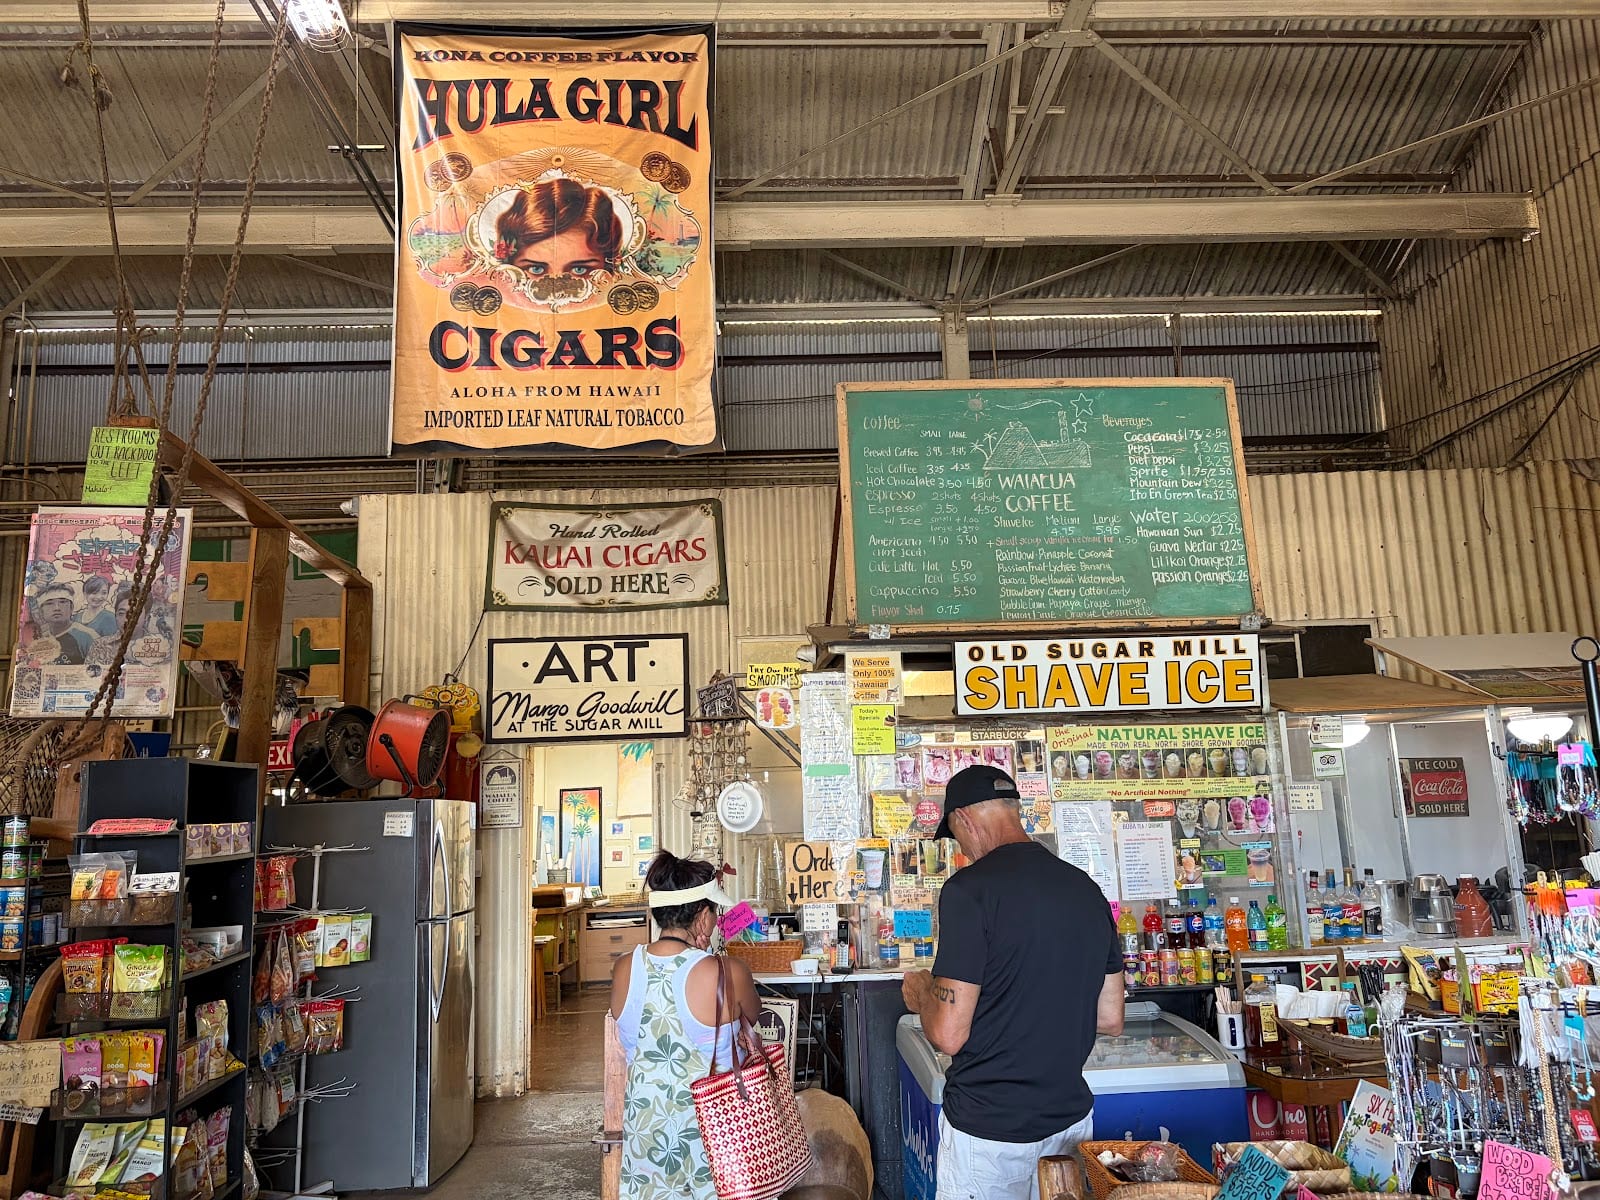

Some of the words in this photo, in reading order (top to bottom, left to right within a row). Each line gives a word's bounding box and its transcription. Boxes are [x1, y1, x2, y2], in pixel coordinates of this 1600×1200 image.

[413, 50, 482, 62] KONA
[489, 50, 592, 62] COFFEE
[596, 50, 699, 63] FLAVOR
[411, 78, 562, 152] HULA
[566, 77, 699, 152] GIRL
[429, 315, 686, 371] CIGARS
[450, 386, 516, 398] ALOHA
[525, 385, 581, 397] FROM
[589, 384, 661, 397] HAWAII
[423, 410, 503, 429] IMPORTED
[507, 409, 542, 427] LEAF
[545, 409, 613, 427] NATURAL
[617, 407, 684, 426] TOBACCO
[863, 415, 901, 430] Coffee
[1102, 414, 1153, 429] Beverages
[95, 429, 156, 445] RESTROOMS
[920, 430, 942, 438] SMALL
[90, 445, 111, 459] OUT
[863, 446, 891, 457] Brewed
[894, 446, 919, 457] Coffee
[1128, 443, 1154, 454] Pepsi
[1129, 455, 1149, 466] Diet
[111, 462, 143, 479] LEFT
[865, 463, 884, 474] Iced
[888, 463, 918, 474] Coffee
[926, 464, 945, 475] 3.25
[1130, 466, 1169, 478] Sprite
[887, 475, 936, 487] Chocolate
[938, 478, 962, 489] 3.50
[1130, 477, 1179, 488] Mountain
[1181, 479, 1201, 488] Dew
[1149, 488, 1161, 499] En
[1165, 489, 1194, 500] Green
[868, 504, 923, 516] Espresso
[934, 504, 958, 514] 3.50
[973, 503, 998, 515] 4.50
[1005, 493, 1077, 513] COFFEE
[900, 517, 922, 525] Ice
[1045, 514, 1080, 526] Medium
[1092, 514, 1122, 527] Large
[1130, 507, 1179, 524] Water
[549, 523, 596, 539] Hand
[598, 524, 660, 539] Rolled
[1050, 526, 1076, 536] 4.75
[1095, 525, 1121, 535] 5.95
[1184, 526, 1203, 537] Sun
[868, 534, 922, 546] Americano
[1150, 541, 1180, 552] Guava
[1184, 539, 1218, 552] Nectar
[1219, 539, 1244, 552] $2.25
[504, 541, 593, 569] KAUAI
[602, 537, 707, 568] CIGARS
[995, 549, 1034, 562] Rainbow
[1078, 547, 1114, 560] Coconut
[950, 560, 972, 572] 5.50
[1049, 561, 1077, 574] Lychee
[1080, 561, 1112, 572] Banana
[543, 575, 602, 597] SOLD
[611, 573, 670, 594] HERE
[924, 574, 944, 584] Iced
[952, 573, 977, 583] 5.50
[998, 574, 1027, 586] Guava
[1078, 571, 1126, 584] Watermelon
[869, 586, 940, 600] Cappuccino
[953, 586, 977, 598] 5.50
[1000, 586, 1045, 598] Strawberry
[1048, 586, 1076, 598] Cherry
[871, 605, 901, 618] Flavor
[936, 604, 962, 615] 0.75
[1049, 598, 1081, 611] Papaya
[1084, 598, 1112, 611] Grape
[967, 645, 1028, 662] OLD
[1046, 640, 1156, 660] SUGAR
[1173, 637, 1247, 657] MILL
[533, 640, 650, 684] ART
[749, 673, 801, 687] SMOOTHIES
[853, 670, 871, 678] Only
[874, 669, 895, 677] 100%
[854, 680, 889, 688] Hawaiian
[963, 660, 1151, 711] SHAVE
[1164, 657, 1255, 705] ICE
[491, 691, 569, 727] Margo
[576, 688, 685, 724] Goodwill
[859, 708, 878, 716] Today's
[507, 720, 525, 733] AT
[532, 719, 558, 732] THE
[564, 716, 620, 731] SUGAR
[628, 717, 663, 729] MILL
[1052, 730, 1094, 750] Original
[1055, 728, 1070, 736] the
[1096, 727, 1177, 741] NATURAL
[1182, 726, 1235, 740] SHAVE
[1239, 725, 1264, 738] ICE
[1155, 740, 1178, 748] NORTH
[1207, 739, 1233, 747] GROWN
[268, 746, 292, 766] EXI
[1414, 761, 1429, 770] ICE
[1432, 760, 1457, 770] COLD
[1124, 788, 1159, 797] Artificial
[1161, 788, 1192, 798] Nothing"
[1414, 777, 1463, 797] Coca-Cola
[1419, 804, 1440, 814] SOLD
[1443, 802, 1466, 813] HERE
[793, 843, 847, 873] Order
[798, 874, 845, 899] Here
[1367, 1094, 1385, 1114] SIX
[1245, 1149, 1278, 1181] WOOD
[1488, 1145, 1534, 1175] WOOD
